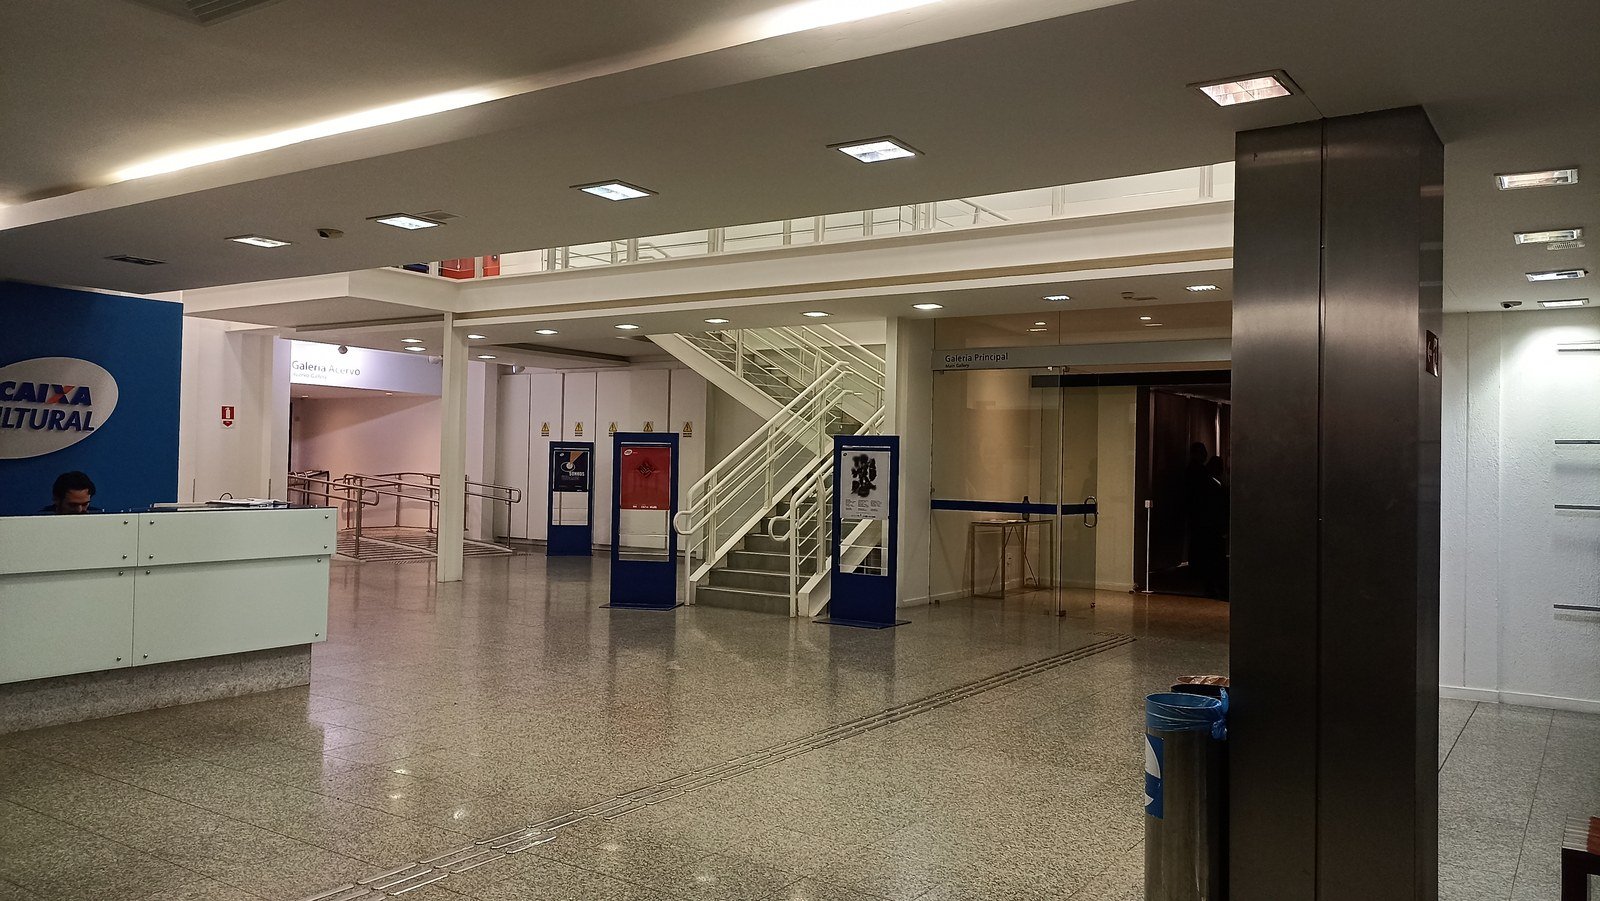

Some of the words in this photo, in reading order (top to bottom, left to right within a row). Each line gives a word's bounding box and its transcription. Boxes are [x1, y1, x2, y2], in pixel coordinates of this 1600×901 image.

[945, 354, 972, 362] Galeria
[974, 352, 1008, 362] Principal
[292, 360, 326, 372] Galeria
[329, 365, 361, 376] Acervo
[0, 380, 92, 406] CAIXA
